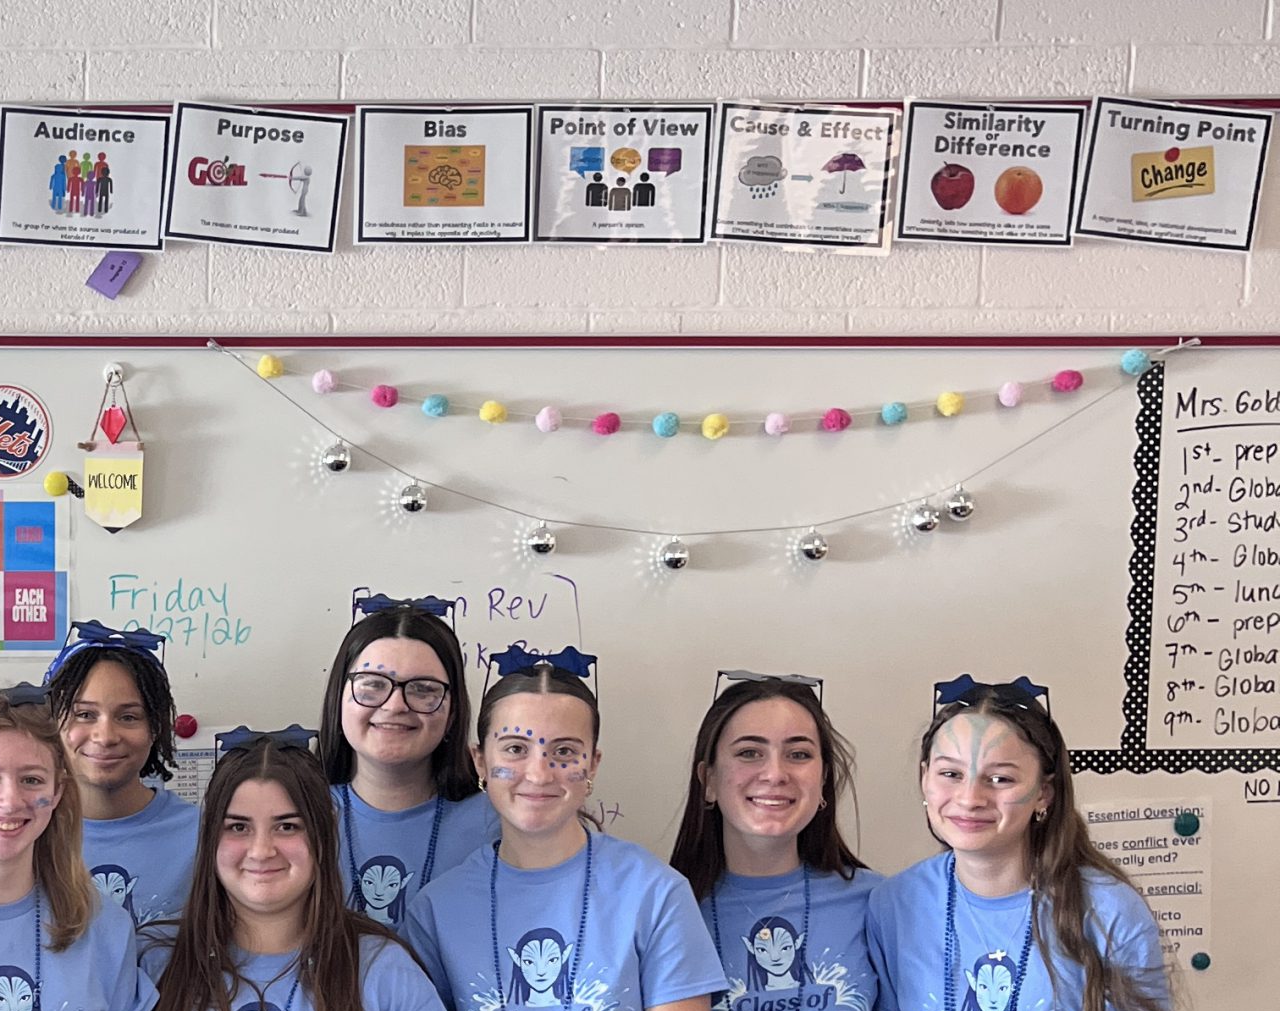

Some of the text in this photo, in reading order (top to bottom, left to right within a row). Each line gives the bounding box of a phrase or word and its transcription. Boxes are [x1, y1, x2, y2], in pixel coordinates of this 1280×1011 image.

[34, 121, 135, 143] Audience
[217, 118, 305, 144] Purpose
[424, 120, 467, 138] Bias
[550, 118, 699, 136] Point of View
[730, 116, 883, 141] Cause & Effect
[944, 111, 1046, 138] Similarity
[1108, 110, 1257, 143] Turning Point
[935, 135, 1051, 158] Difference
[985, 133, 1000, 141] or
[1141, 161, 1208, 189] Change
[1176, 387, 1228, 419] Mrs.
[1236, 443, 1278, 470] prep
[88, 473, 138, 491] WELCOME
[1233, 543, 1280, 568] Glob
[15, 588, 45, 605] EACH
[109, 574, 229, 616] Friday
[488, 588, 548, 621] Rev
[12, 605, 48, 622] OTHER
[1234, 612, 1280, 640] prep
[1219, 645, 1278, 671] Globa
[1215, 674, 1276, 697] Globa
[1214, 706, 1280, 735] Globa
[1244, 779, 1270, 799] NO
[1088, 806, 1204, 822] Essential Question:
[1122, 837, 1168, 850] conflict
[1172, 837, 1202, 846] ever
[1148, 852, 1178, 863] end?
[1147, 882, 1203, 895] esencial:
[1159, 925, 1203, 937] ermina
[807, 988, 834, 1011] of
